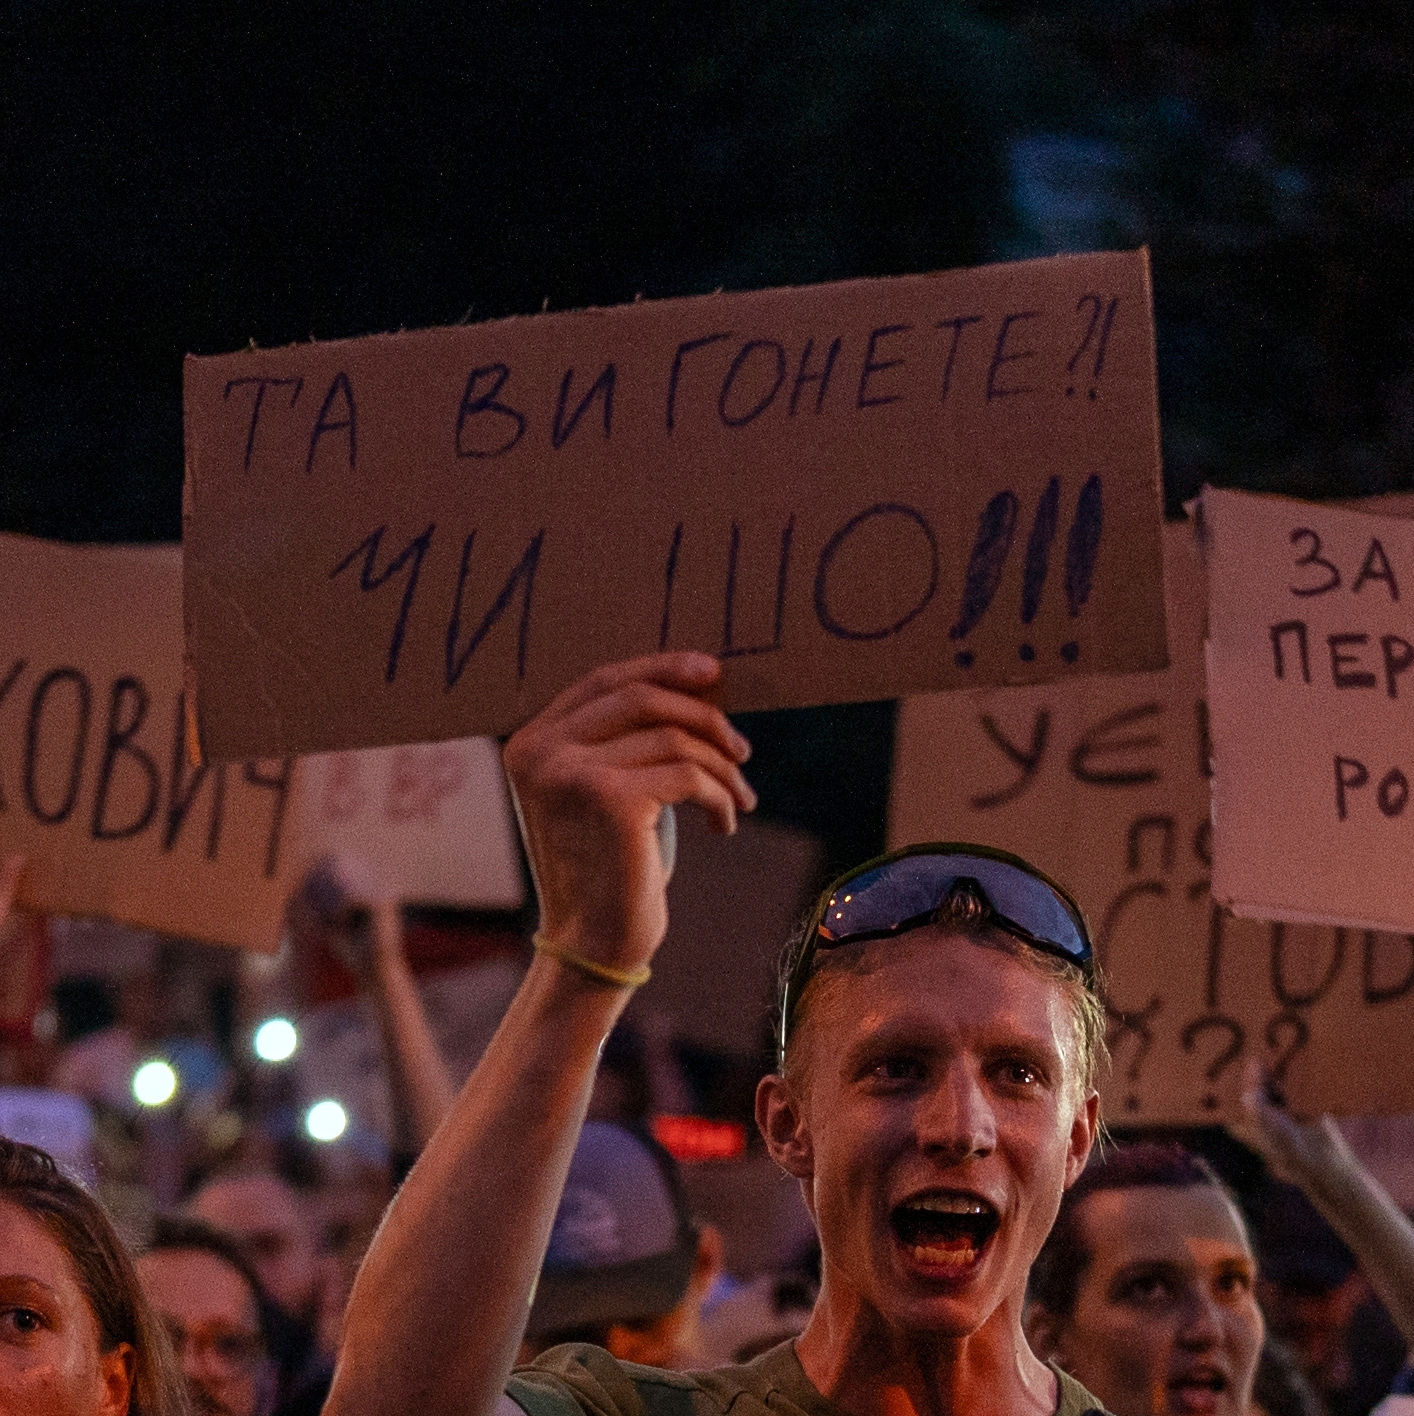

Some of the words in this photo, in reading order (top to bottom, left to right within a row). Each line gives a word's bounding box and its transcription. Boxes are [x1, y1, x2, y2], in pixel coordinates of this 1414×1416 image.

[226, 373, 362, 473] ТА
[330, 522, 546, 694] ЧИ
[657, 473, 1105, 667] ШО!!!
